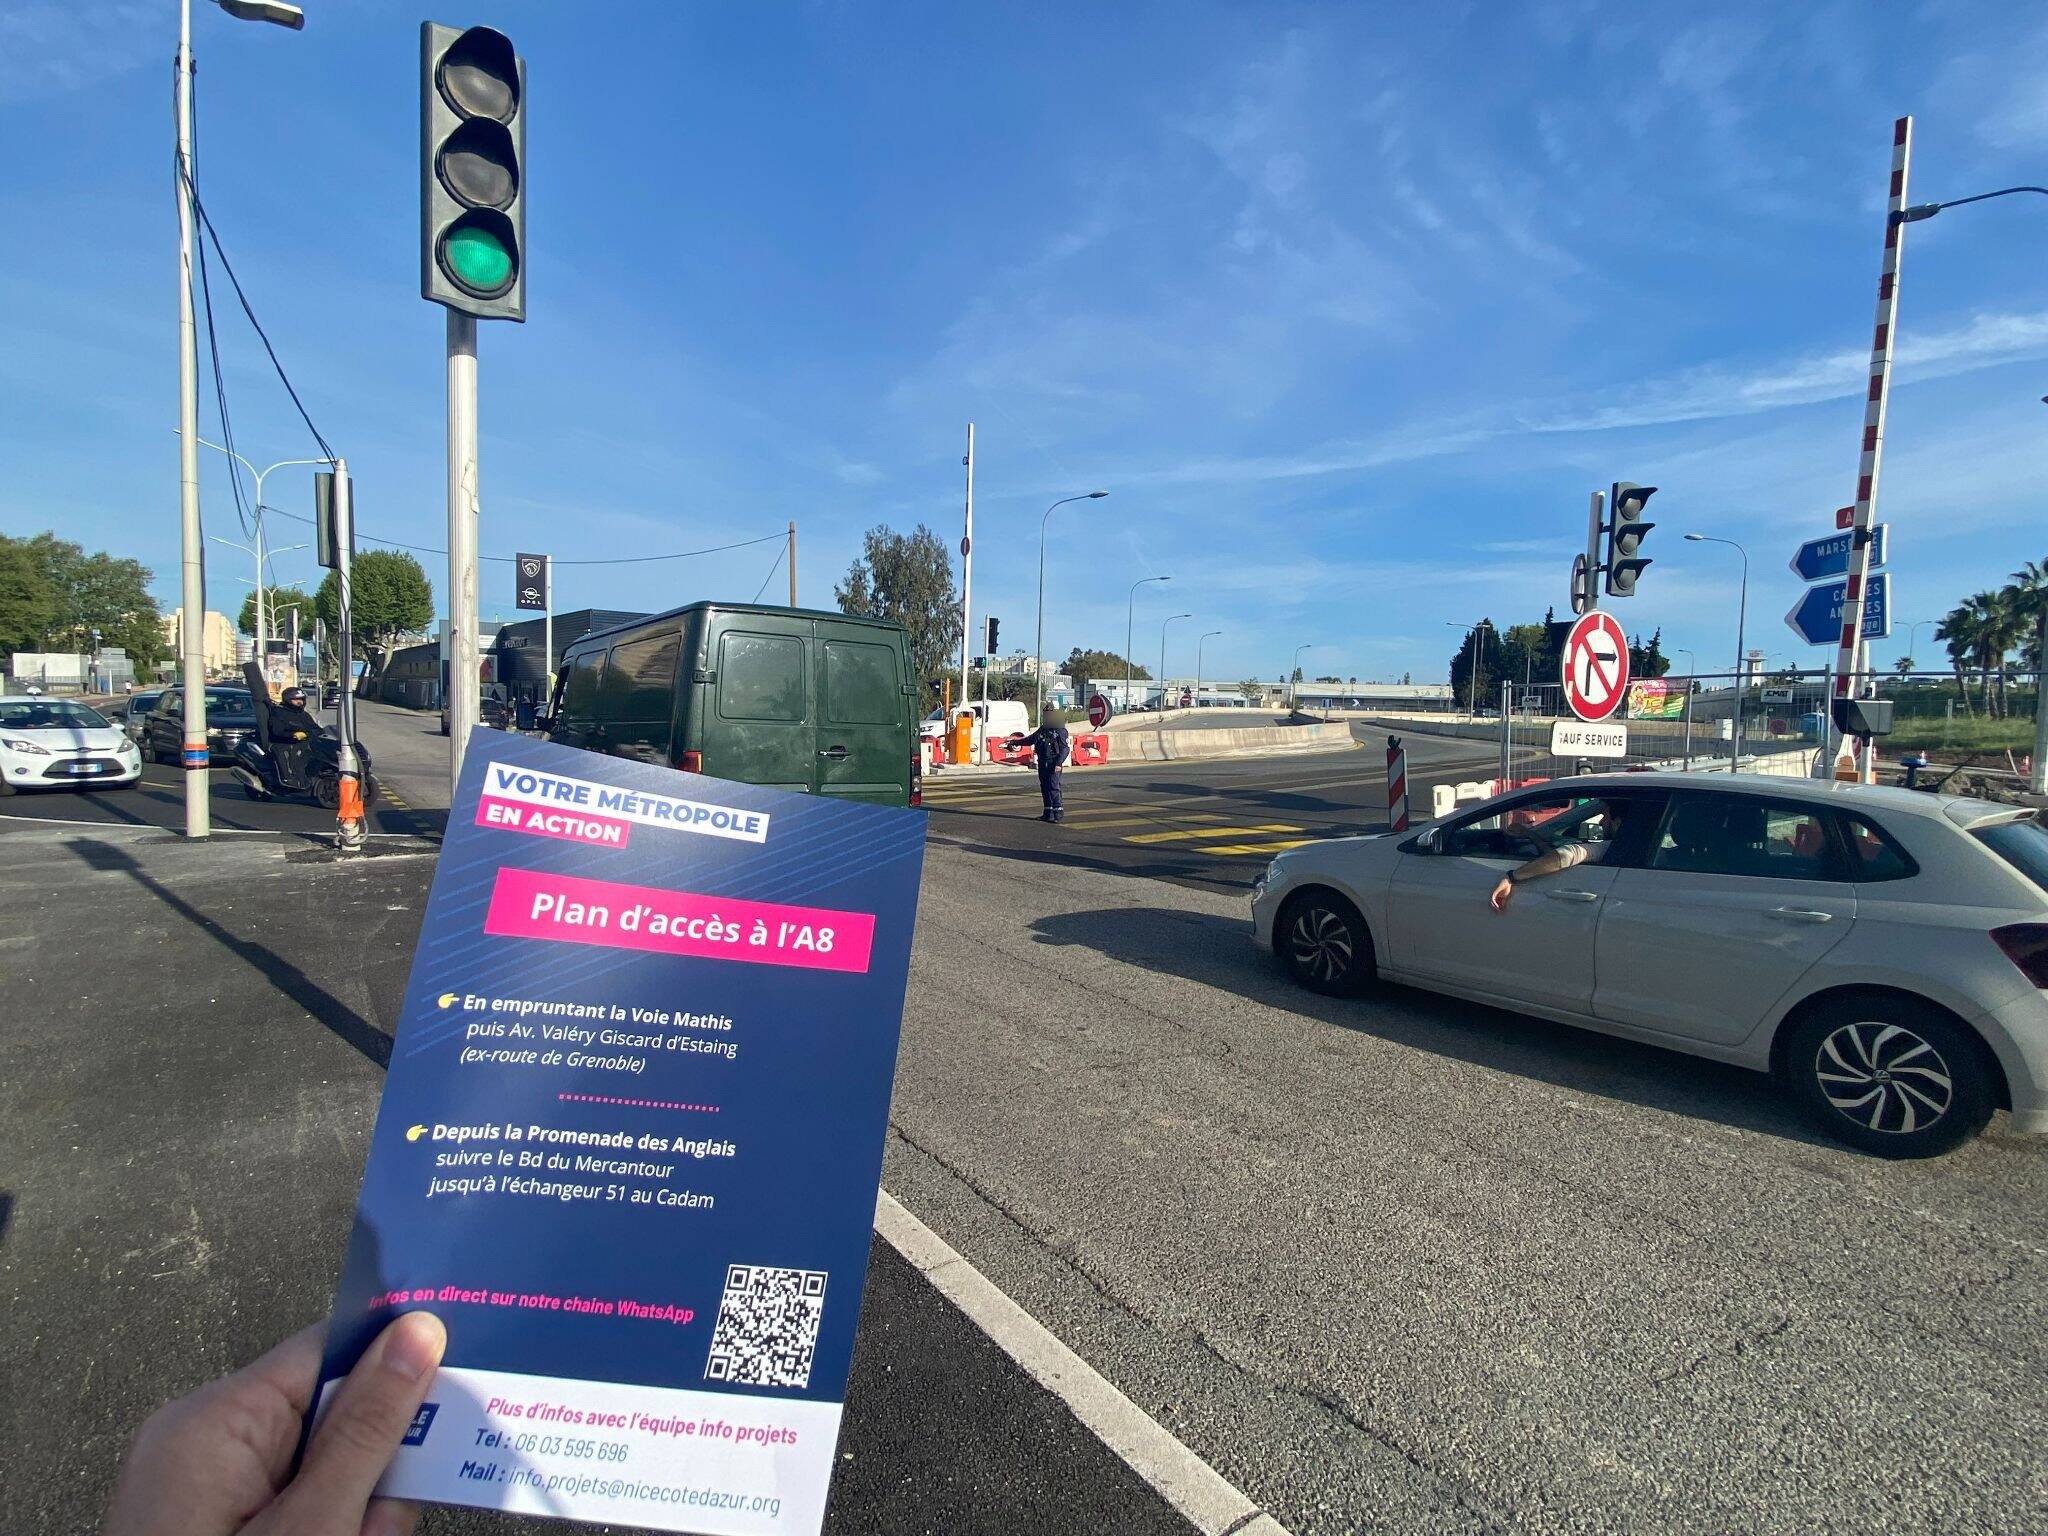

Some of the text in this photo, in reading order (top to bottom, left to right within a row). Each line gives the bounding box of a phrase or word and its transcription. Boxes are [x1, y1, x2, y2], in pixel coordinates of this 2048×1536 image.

[1584, 733, 1624, 747] SERVICE
[496, 769, 760, 834] VOTRE MÉTROPOLE
[485, 803, 622, 843] EN ACTION
[530, 892, 835, 953] Plan d’accès à l’A8
[463, 994, 733, 1031] En empruntant la Voie Mathis
[466, 1021, 738, 1059] puis Av. Valéry Giscard d’Estaing
[460, 1046, 646, 1074] (ex-route de Grenoble)
[431, 1122, 737, 1159] Depuis la Promenade des Anglais
[435, 1149, 675, 1178] suivre le Bd du Mercantour
[426, 1174, 715, 1209] jusqu’à l’échangeur 51 au Cadam
[412, 1287, 435, 1302] en
[437, 1285, 488, 1304] direct
[490, 1291, 518, 1306] sur
[519, 1293, 561, 1310] notre
[616, 1299, 695, 1325] WhatsApp
[485, 1397, 798, 1447] Plus d’infos avec l’équipe info projets
[474, 1427, 503, 1448] Tel
[514, 1433, 538, 1452] 06
[539, 1436, 562, 1456] 03
[563, 1438, 596, 1459] 595
[597, 1441, 629, 1463] 696
[458, 1459, 498, 1481] Mail
[508, 1465, 781, 1518] info.projets@nicecotedazur.org
